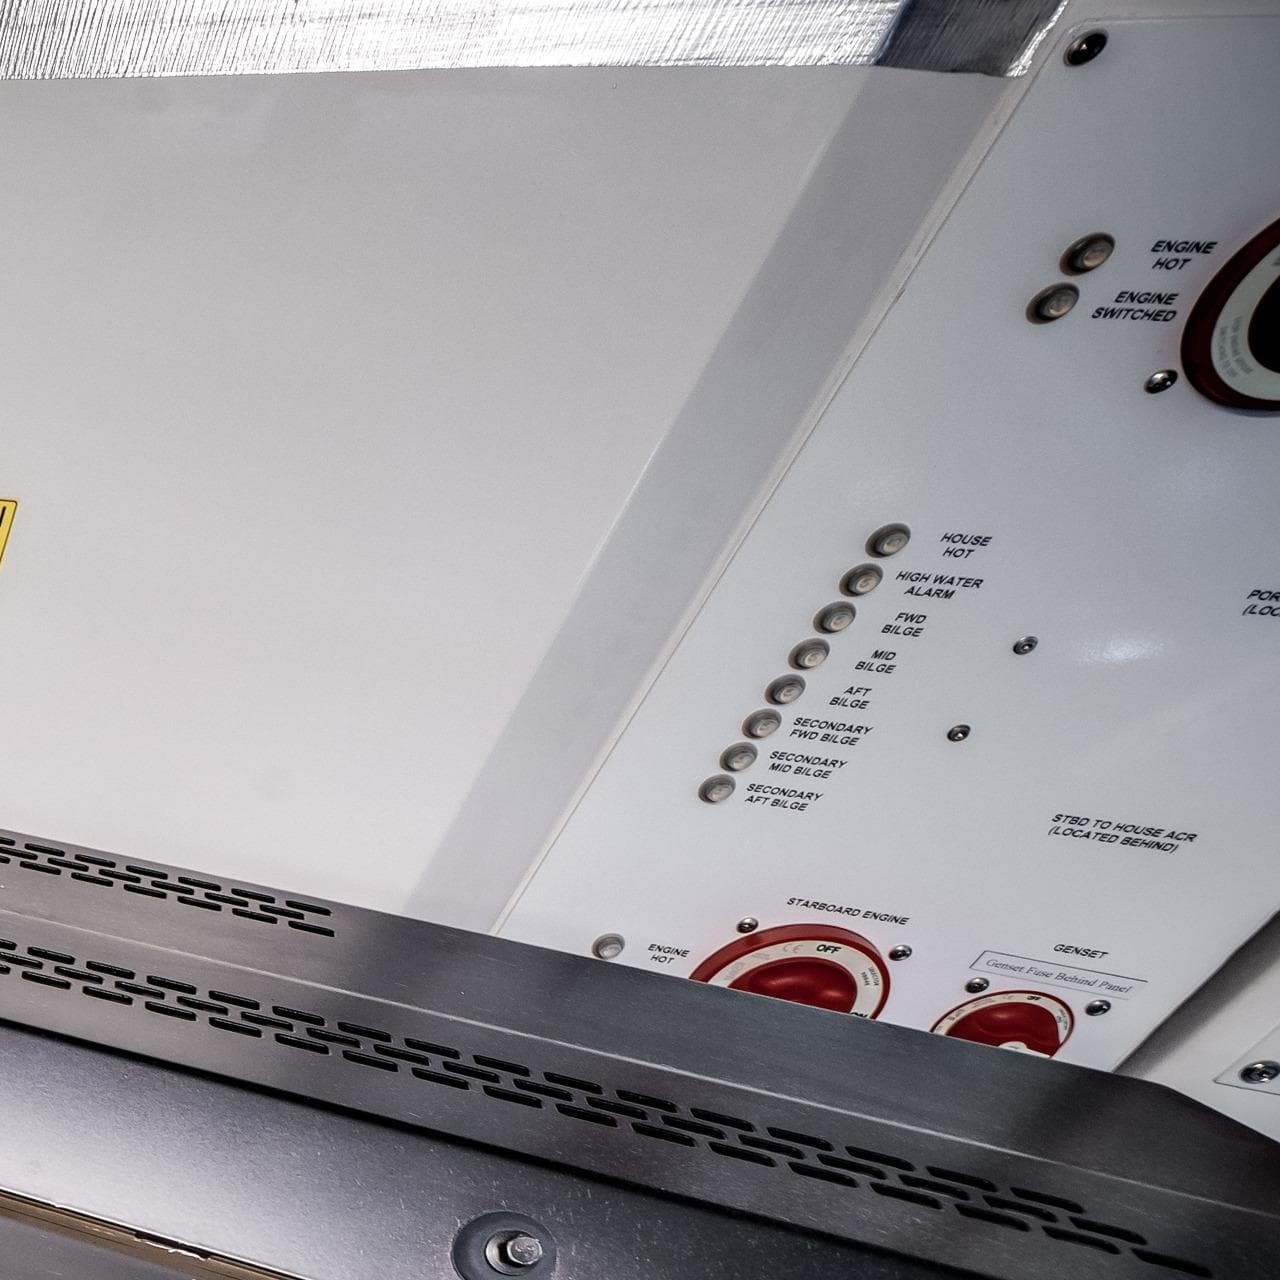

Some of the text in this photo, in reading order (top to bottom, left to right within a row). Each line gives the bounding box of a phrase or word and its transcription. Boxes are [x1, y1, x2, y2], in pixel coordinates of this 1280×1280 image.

[1151, 240, 1217, 254] ENGINE
[1152, 258, 1192, 270] HOT
[1115, 291, 1179, 305] ENGINE
[1091, 307, 1177, 322] SWITCHED
[940, 532, 992, 547] HOUSE
[942, 547, 975, 559] HOT
[895, 571, 984, 589] HIGH WATER
[904, 585, 956, 600] ALARM
[895, 612, 927, 624] FWD
[881, 624, 924, 637] BILGE
[871, 650, 897, 661] MID
[855, 661, 896, 674] BILGE
[844, 686, 872, 697] AFT
[829, 696, 870, 710] BILGE
[793, 717, 873, 735] SECONDARY
[790, 729, 860, 746] FWD BILGE
[770, 751, 849, 769] SECONDARY
[769, 762, 832, 779] MID BILGE
[747, 783, 824, 801] SECONDARY
[745, 795, 808, 811] AFT BILGE
[1051, 813, 1198, 843] STBD TO HOUSE ACR
[1048, 826, 1179, 854] (LOCATED BEHIND)
[787, 897, 909, 926] STARBOARD ENGINE
[648, 943, 690, 958] ENGINE
[816, 944, 842, 955] OFF
[1053, 943, 1109, 960] GENSET
[650, 954, 675, 965] HOT
[985, 958, 1134, 995] Genset Fuse Behind Panel
